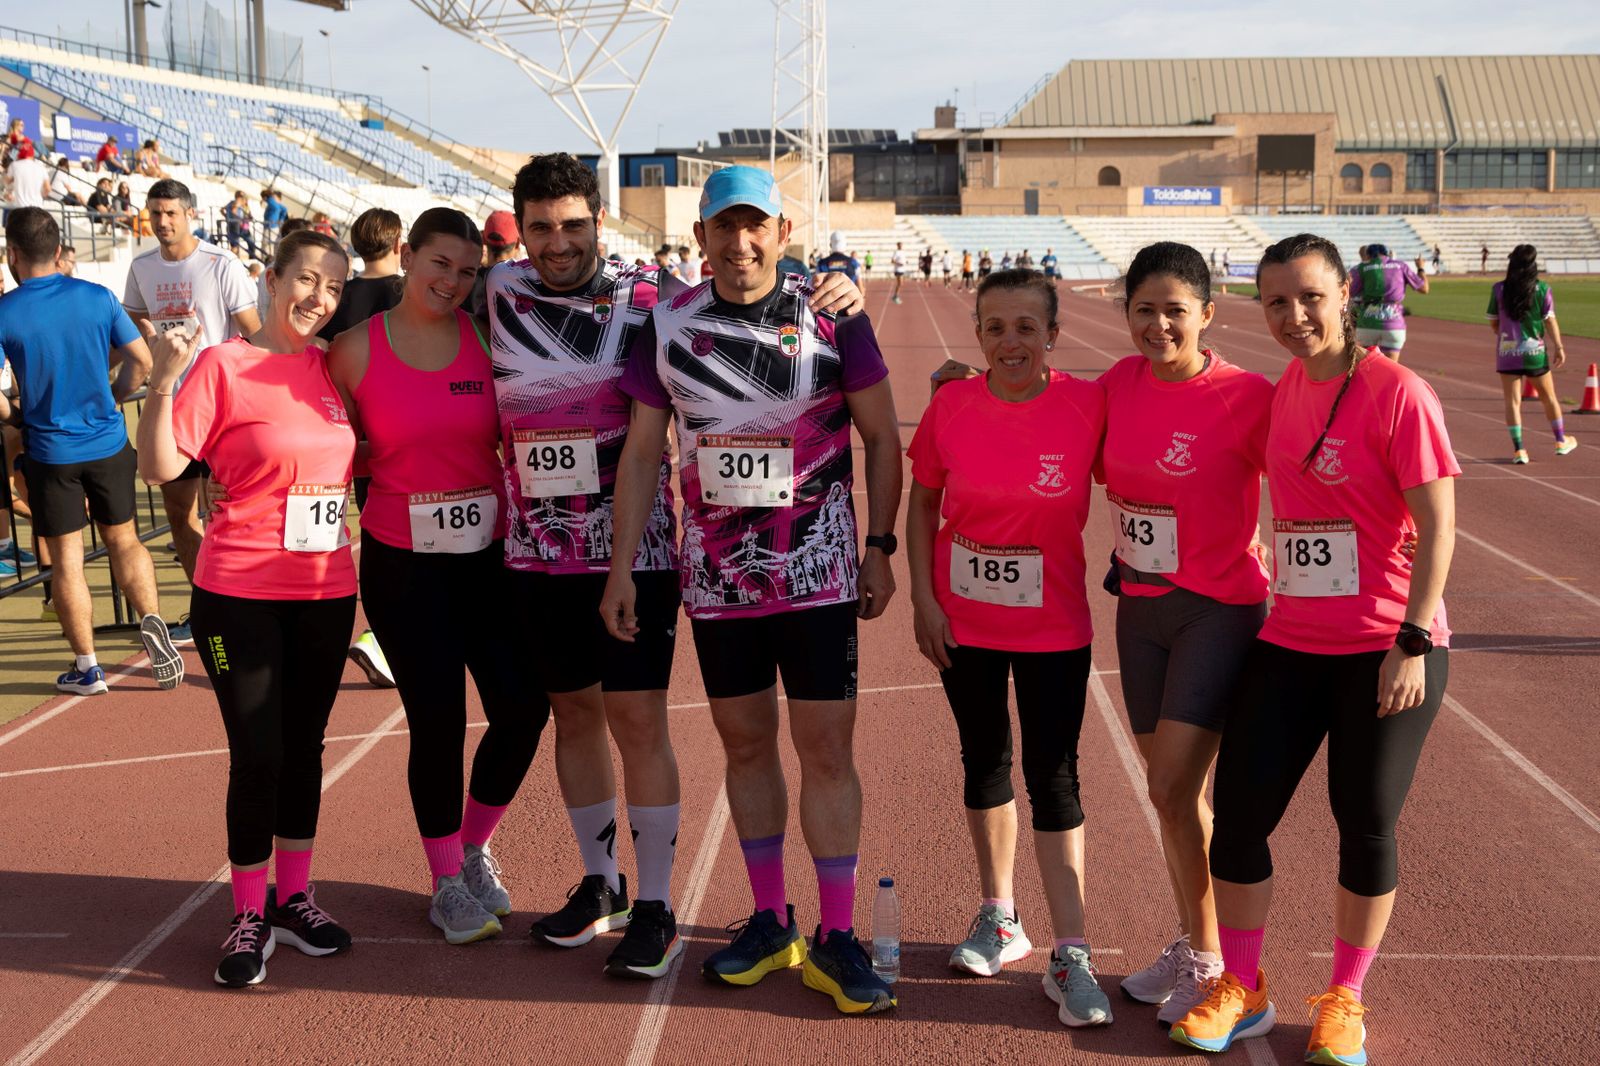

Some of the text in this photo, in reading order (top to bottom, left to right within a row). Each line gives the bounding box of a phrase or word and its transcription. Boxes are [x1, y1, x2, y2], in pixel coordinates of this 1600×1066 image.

[450, 381, 484, 392] DUELT
[1172, 432, 1198, 441] DUELT
[527, 445, 576, 471] 498
[718, 453, 769, 478] 301
[290, 485, 322, 494] XXXVI
[410, 492, 444, 503] XXXVI
[432, 503, 481, 529] 186
[706, 506, 731, 520] TROTE
[1120, 512, 1154, 546] 643
[1285, 538, 1332, 566] 183
[968, 556, 1020, 583] 185
[213, 636, 229, 671] DUELT
